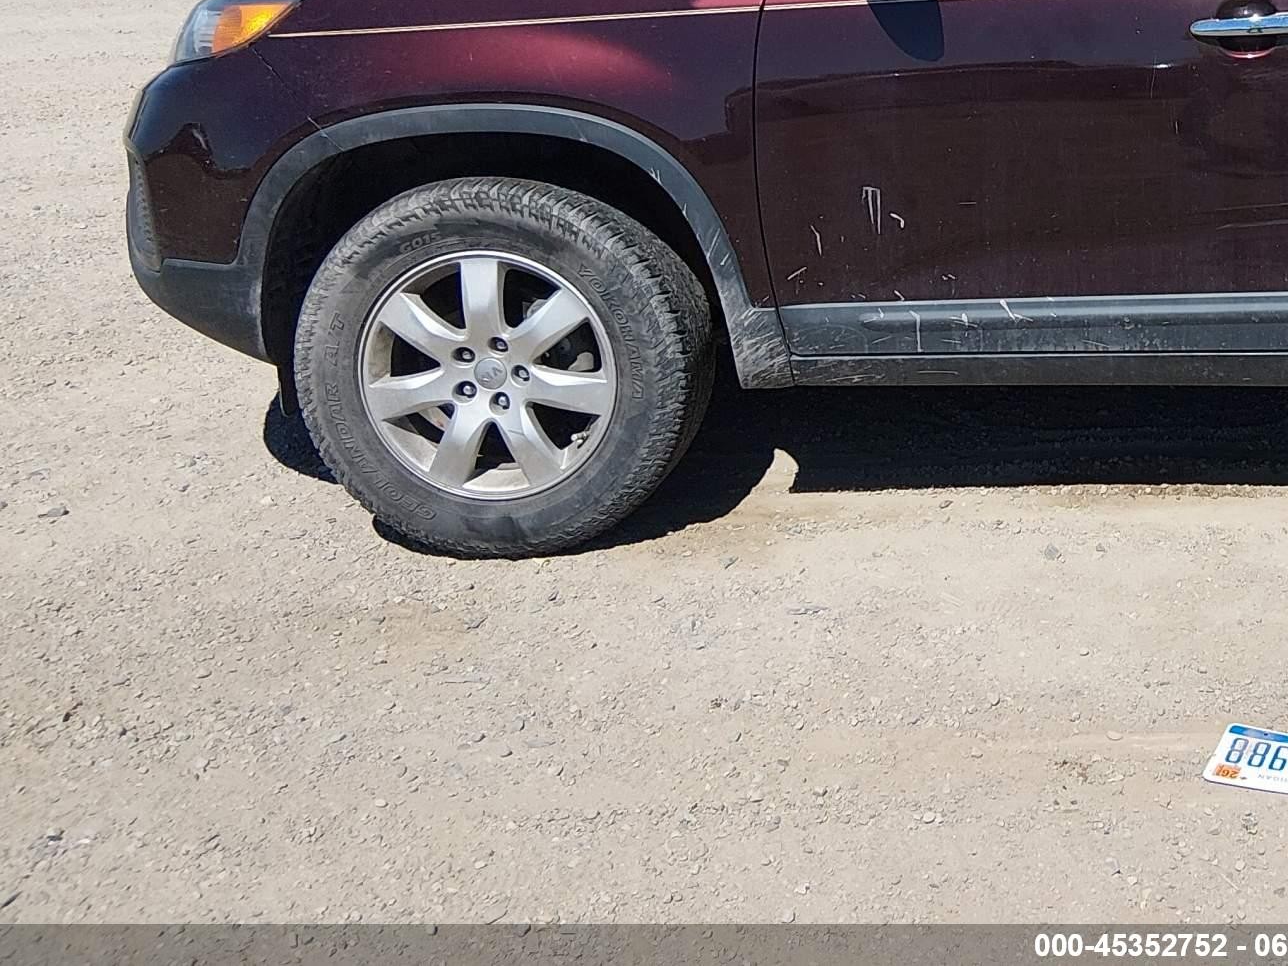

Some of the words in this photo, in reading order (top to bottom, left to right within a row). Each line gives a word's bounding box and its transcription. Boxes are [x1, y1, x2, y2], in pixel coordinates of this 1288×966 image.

[324, 313, 345, 367] A/T
[578, 263, 644, 400] YOKOHAMA
[325, 384, 437, 522] GEOLANDAR
